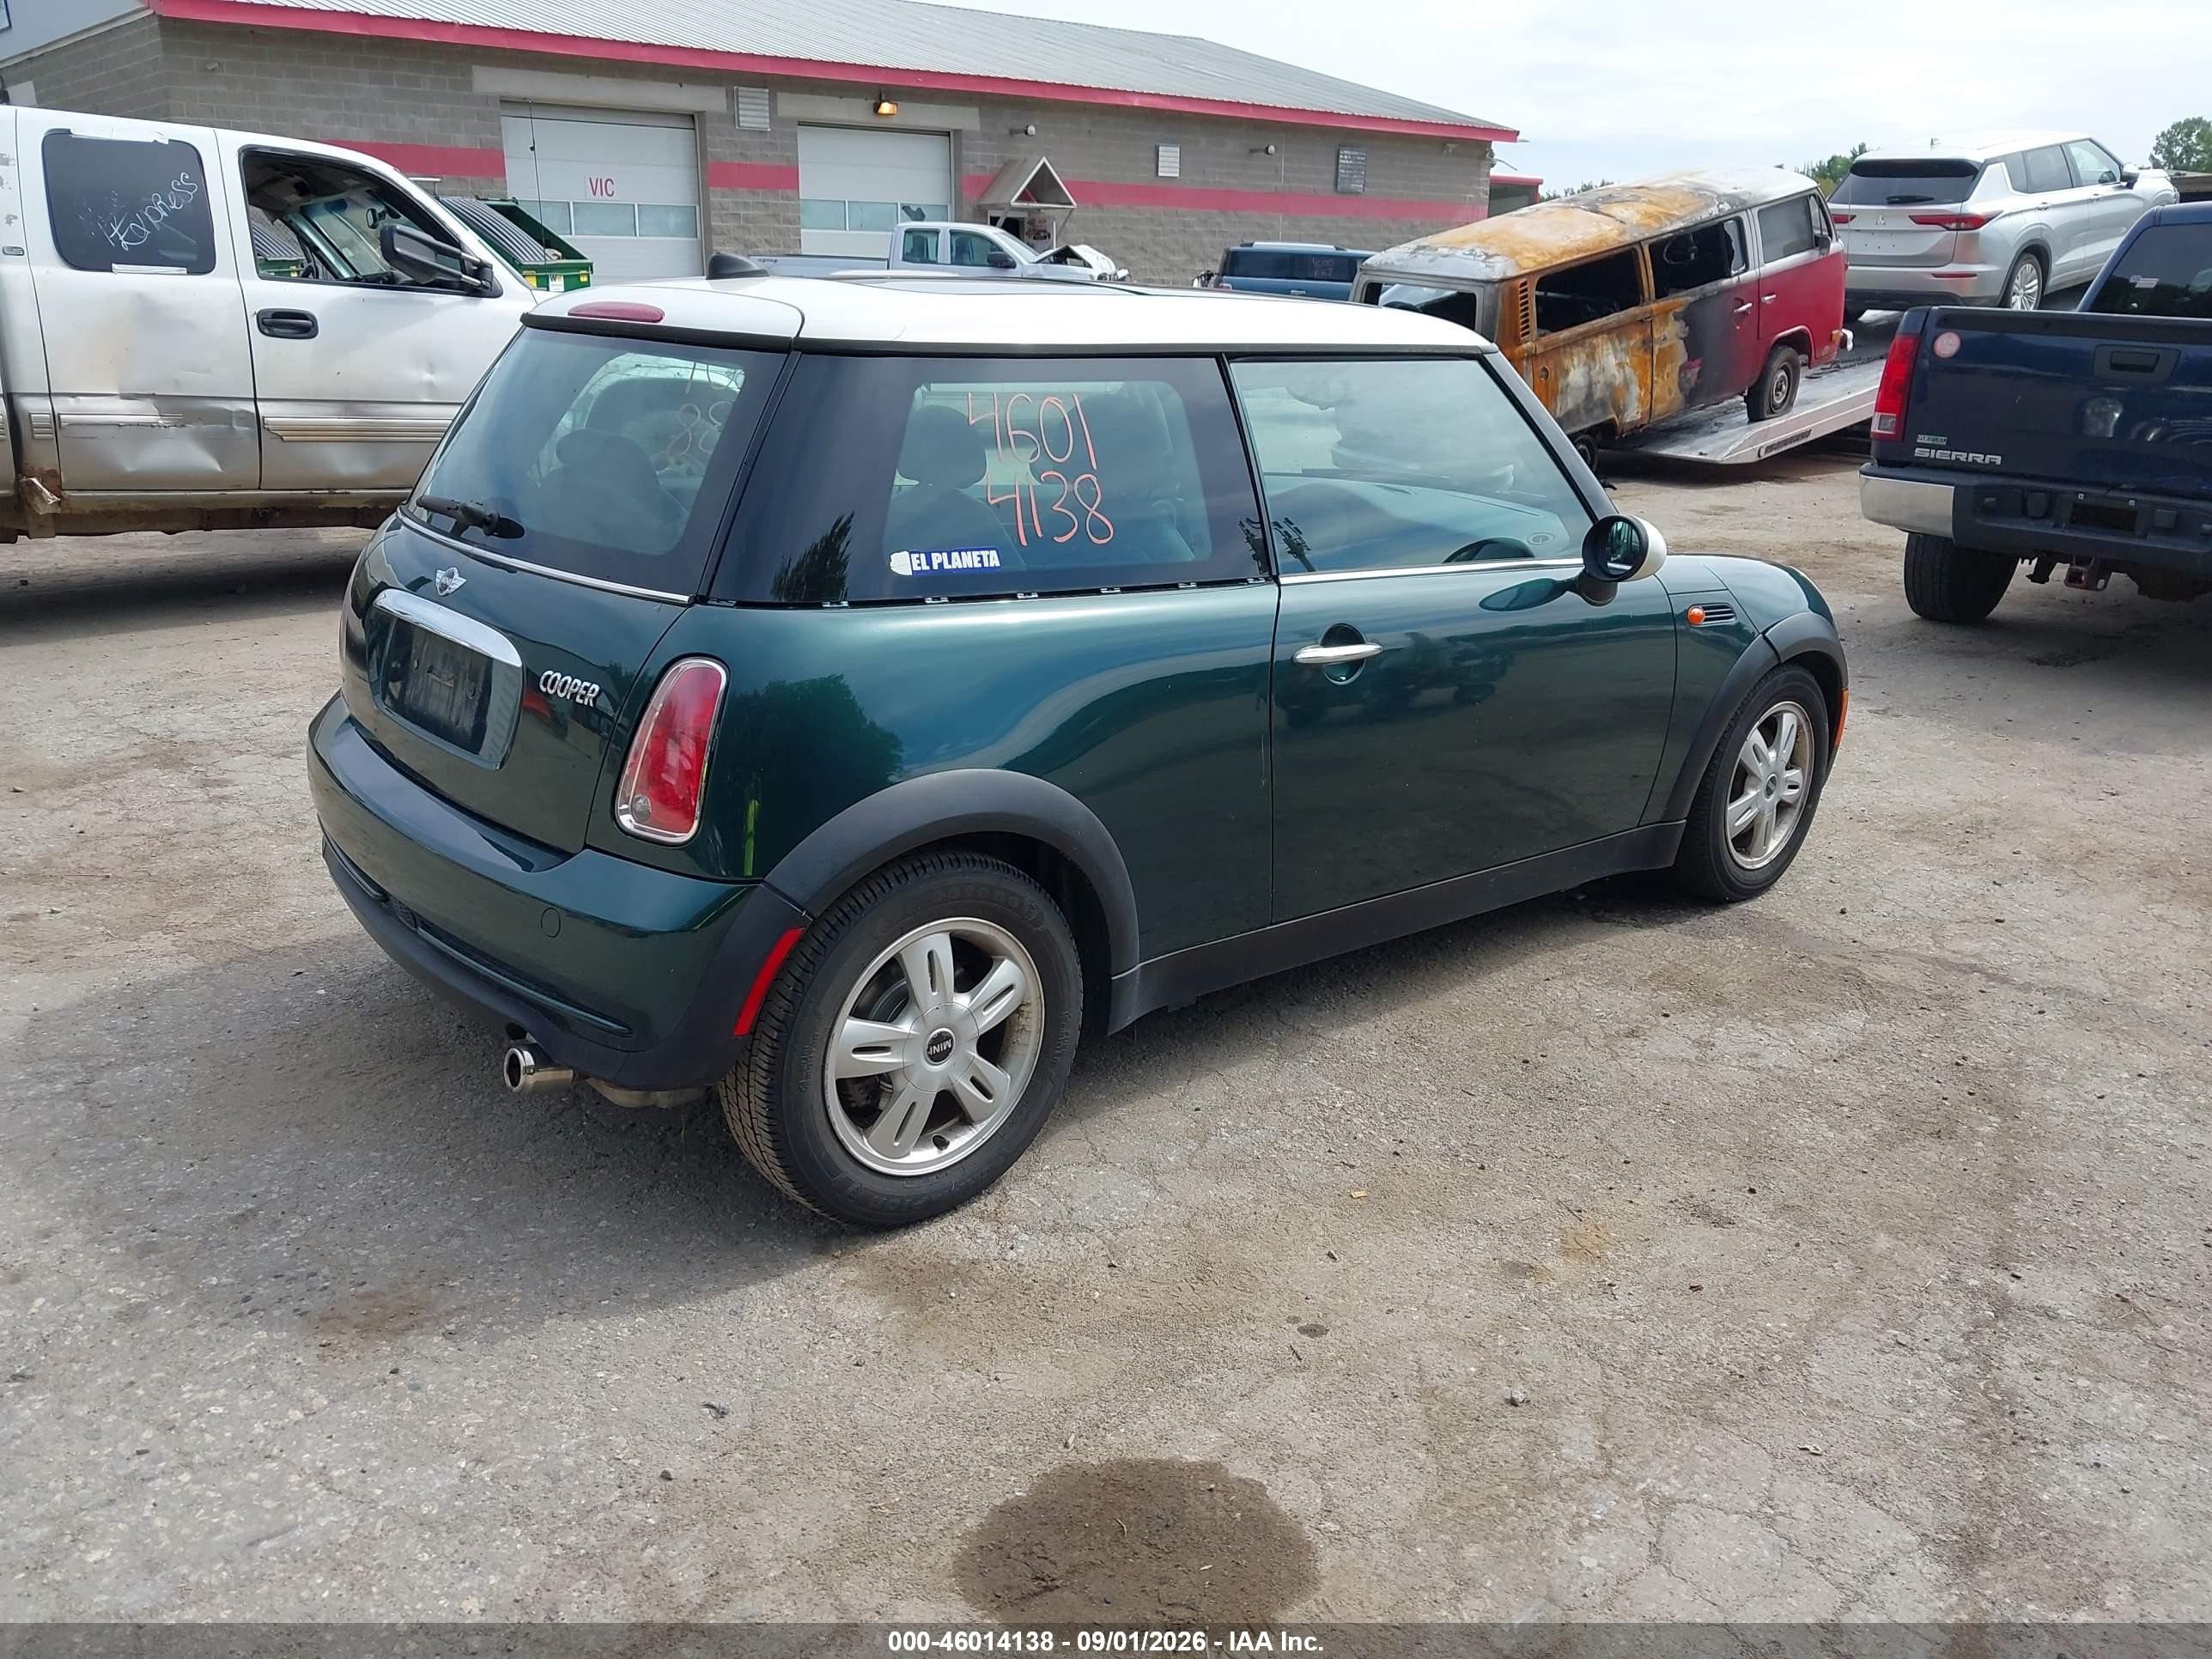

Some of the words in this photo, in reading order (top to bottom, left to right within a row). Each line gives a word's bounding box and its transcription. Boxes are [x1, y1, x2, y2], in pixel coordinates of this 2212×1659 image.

[588, 177, 615, 197] VIC
[968, 392, 1097, 470] 4601
[1914, 447, 2002, 465] SIERRA
[987, 471, 1115, 547] 4138
[911, 553, 930, 571] EL
[931, 550, 1001, 570] PLANETA
[538, 670, 600, 708] COOPER
[929, 1039, 951, 1055] MINI
